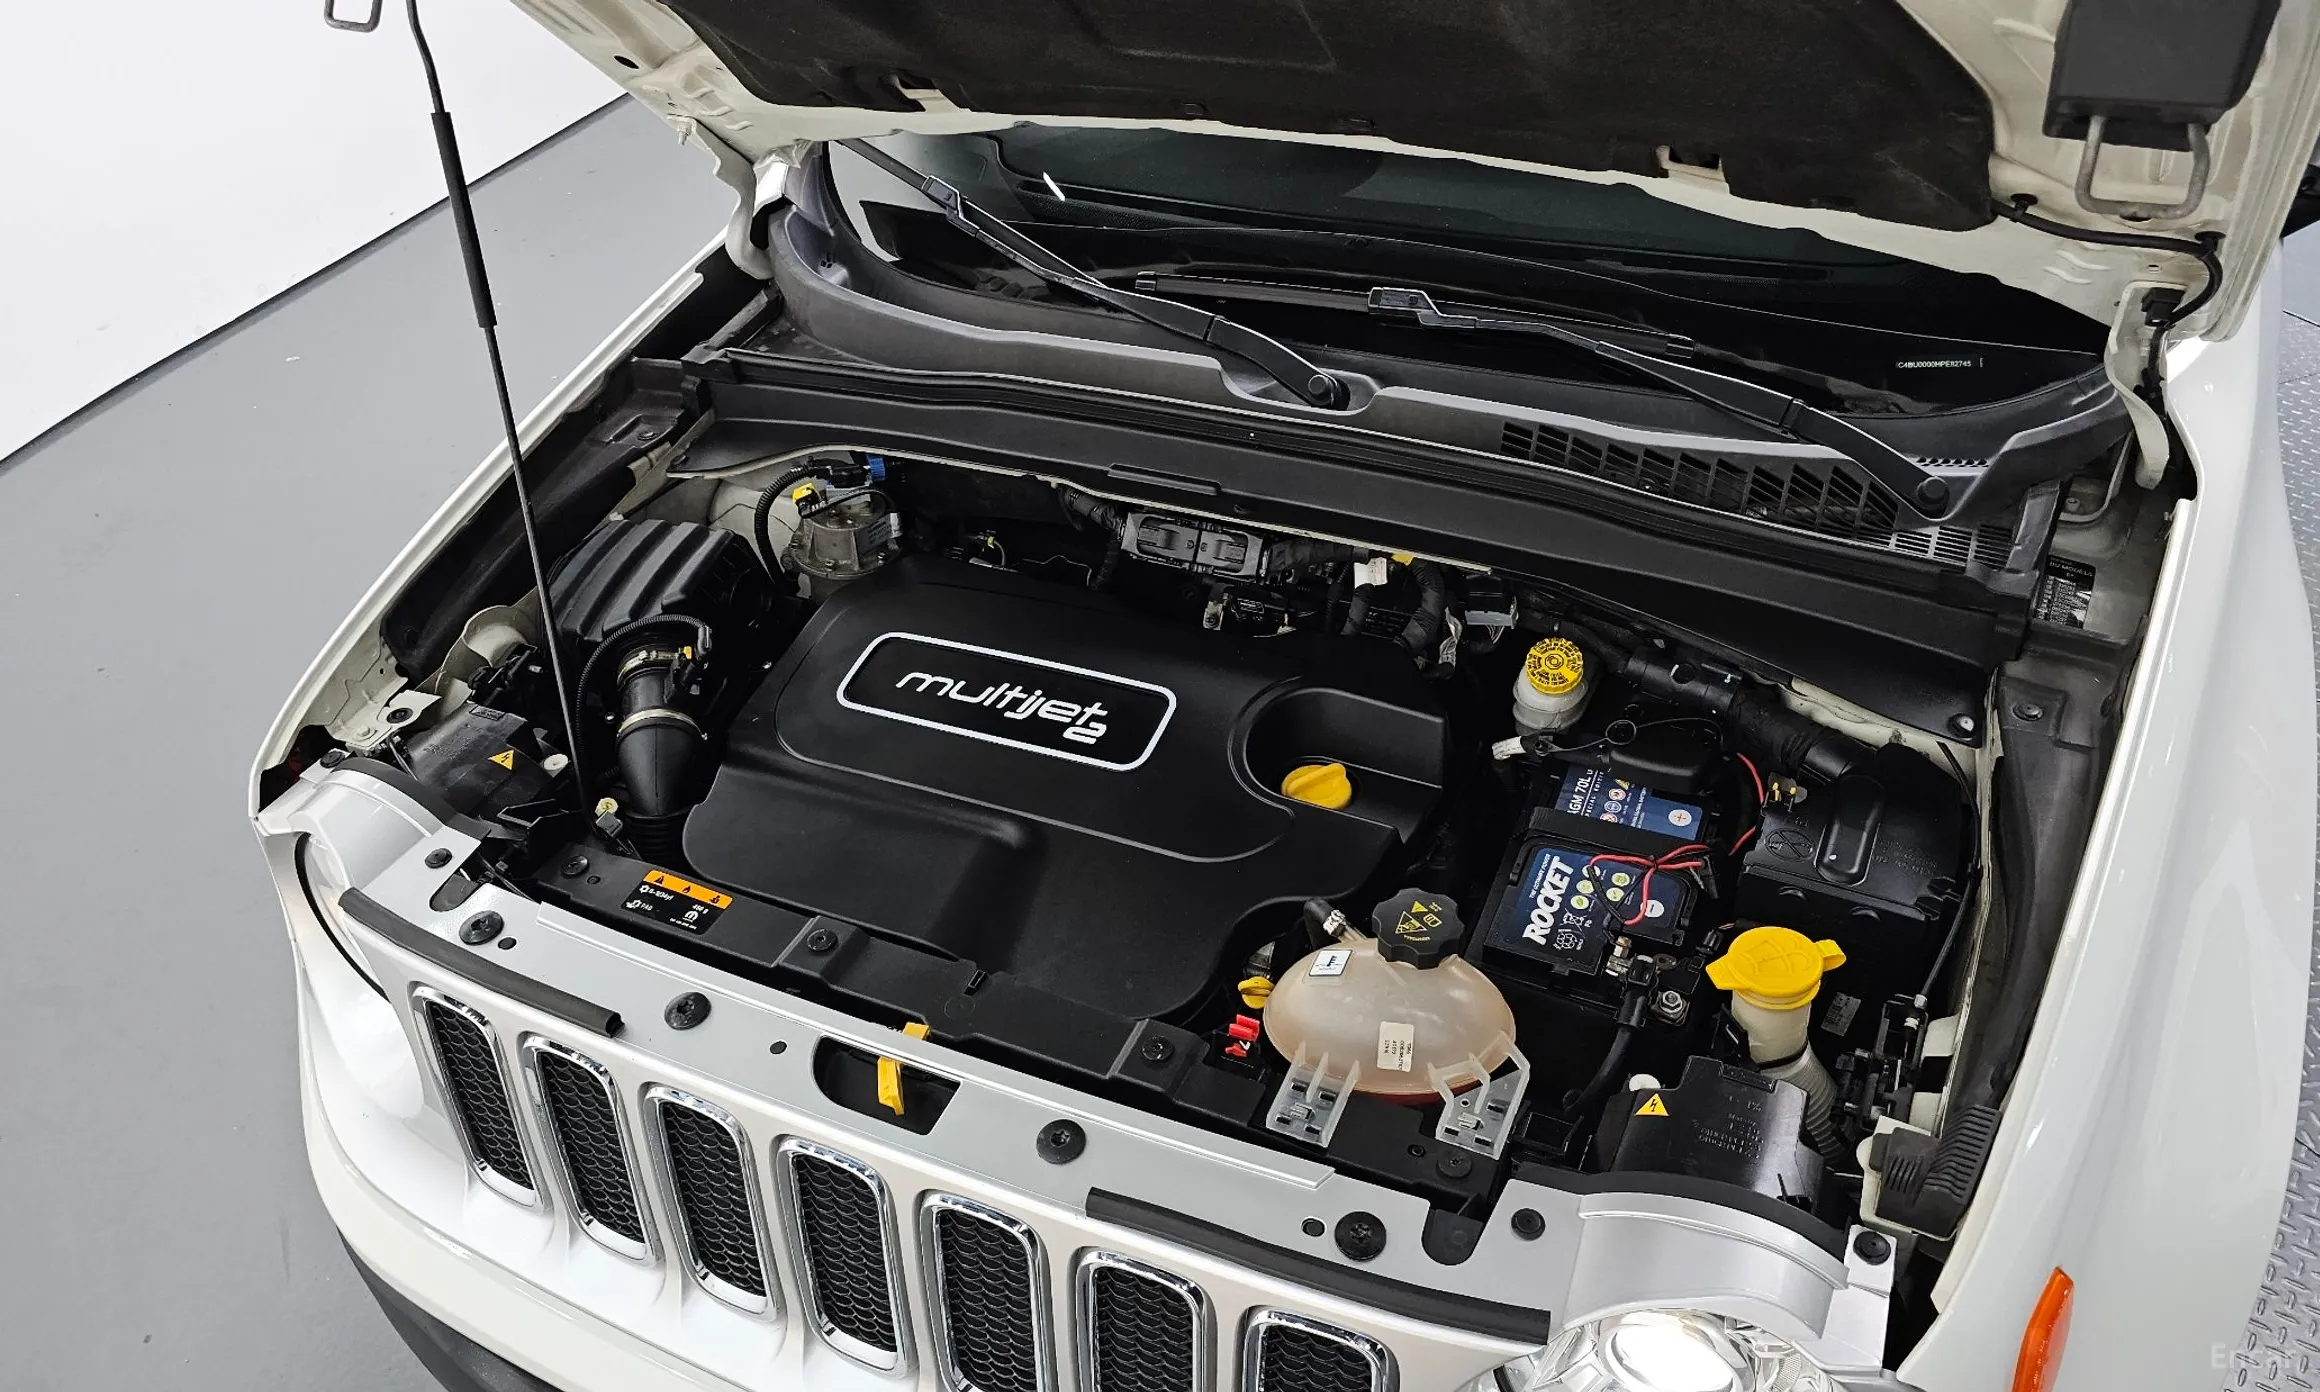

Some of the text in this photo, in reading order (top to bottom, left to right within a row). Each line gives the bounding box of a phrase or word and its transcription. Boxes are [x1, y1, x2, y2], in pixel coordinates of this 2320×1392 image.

[895, 671, 1108, 721] multijet
[1574, 776, 1591, 793] 70L
[1522, 855, 1574, 946] ROCKET
